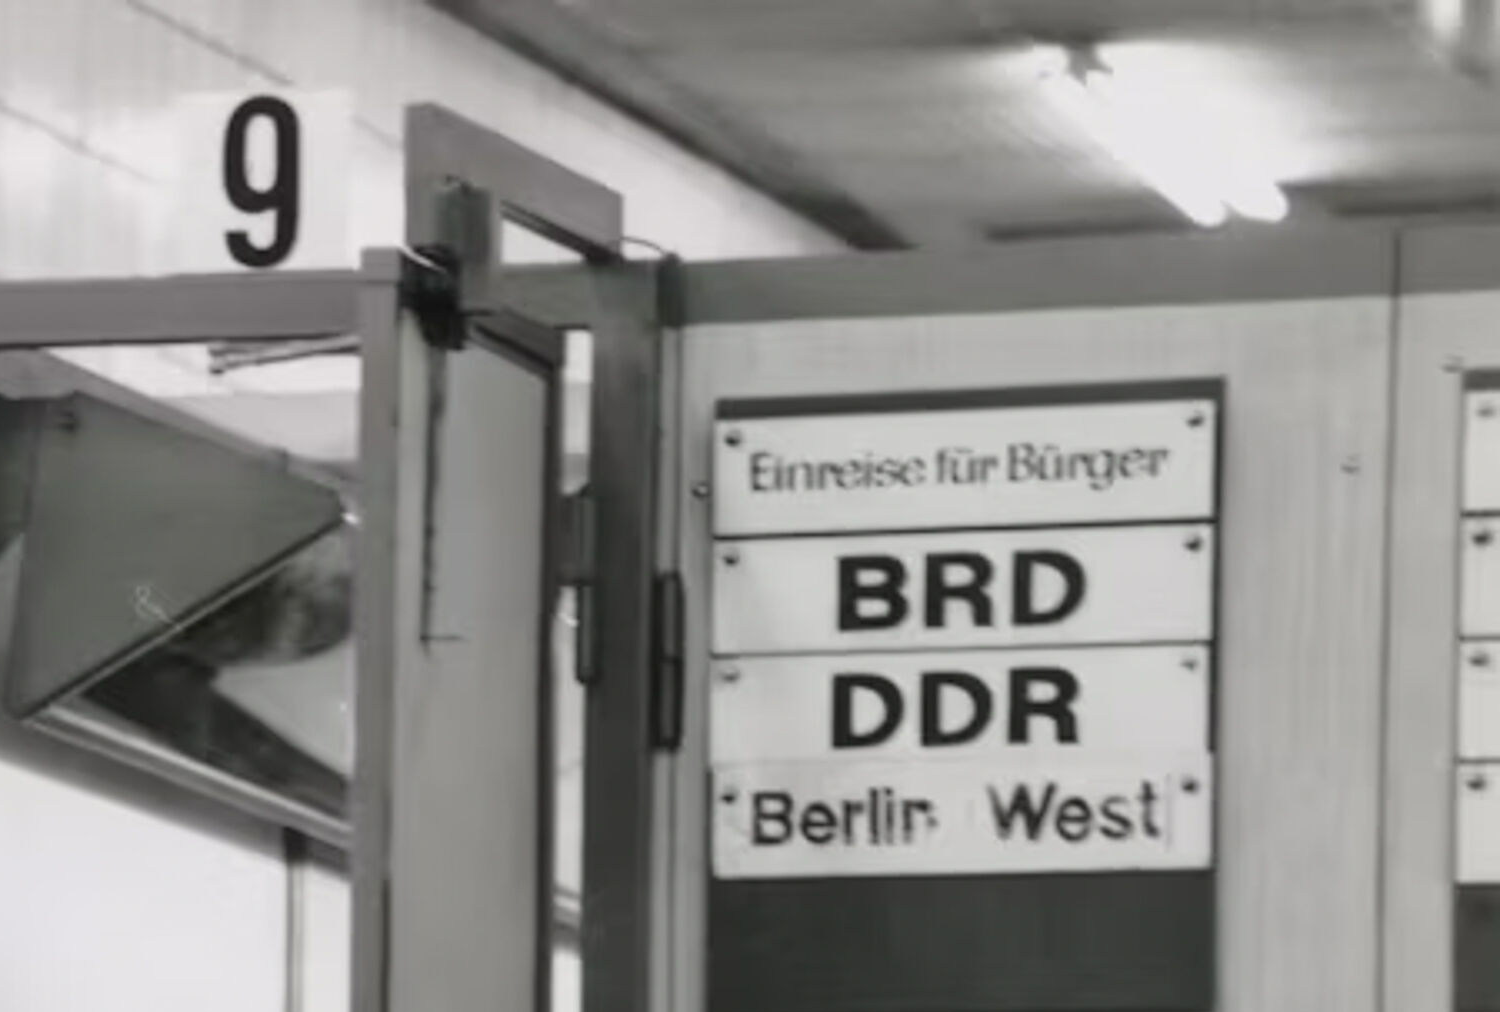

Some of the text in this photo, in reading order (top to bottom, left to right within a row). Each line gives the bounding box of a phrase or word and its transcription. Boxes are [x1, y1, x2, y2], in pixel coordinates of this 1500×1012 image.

[221, 94, 302, 268] 9
[748, 442, 1171, 494] Einreise für Bürger
[836, 549, 1088, 634] BRD
[830, 666, 1081, 751] DDR
[985, 779, 1162, 845] West
